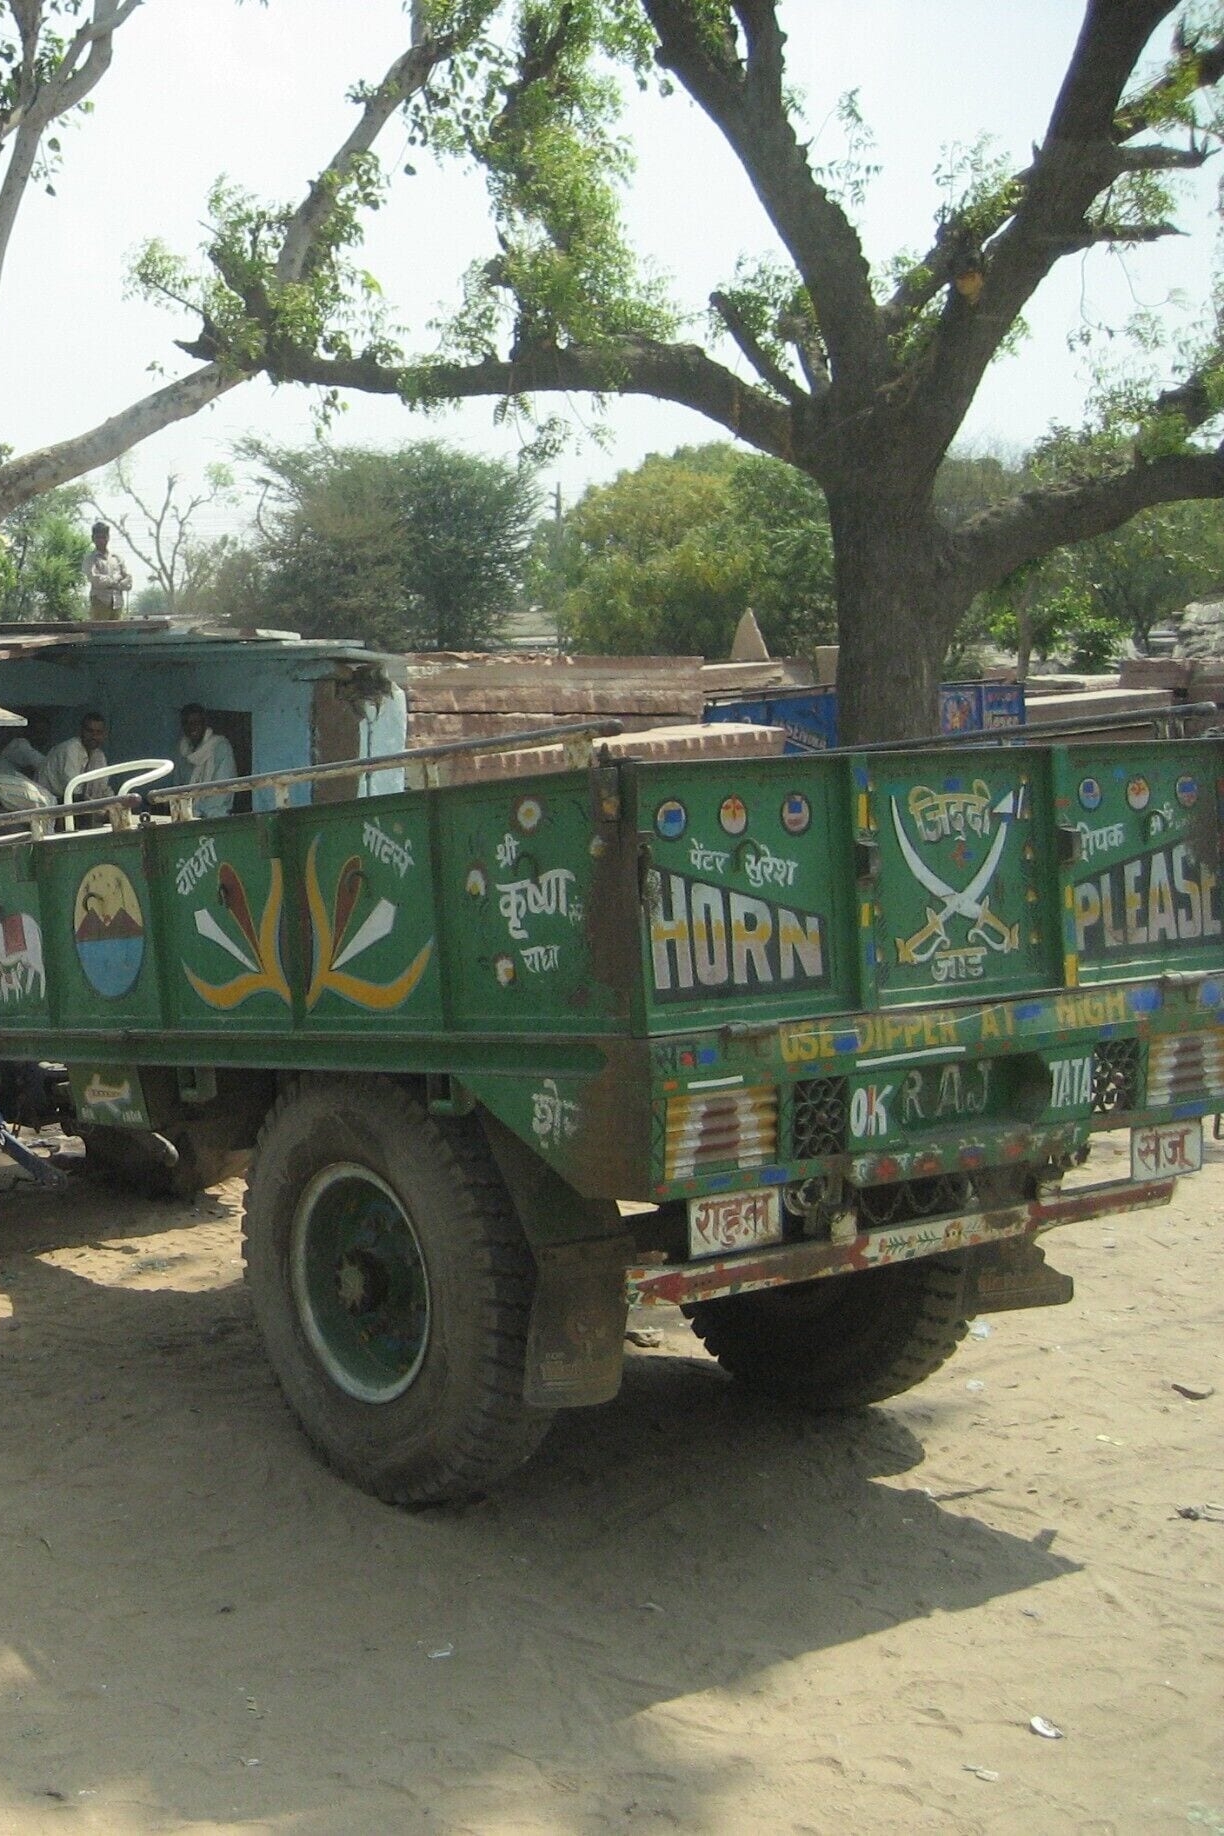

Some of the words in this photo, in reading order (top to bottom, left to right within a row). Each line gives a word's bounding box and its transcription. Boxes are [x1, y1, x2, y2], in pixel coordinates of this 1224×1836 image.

[496, 832, 520, 868] श्री
[744, 843, 799, 887] सुरेश
[1075, 844, 1223, 951] PLEASE
[646, 868, 824, 990] HORN
[779, 1018, 836, 1063] USE
[1048, 1056, 1093, 1108] TATA
[850, 1084, 894, 1138] OK
